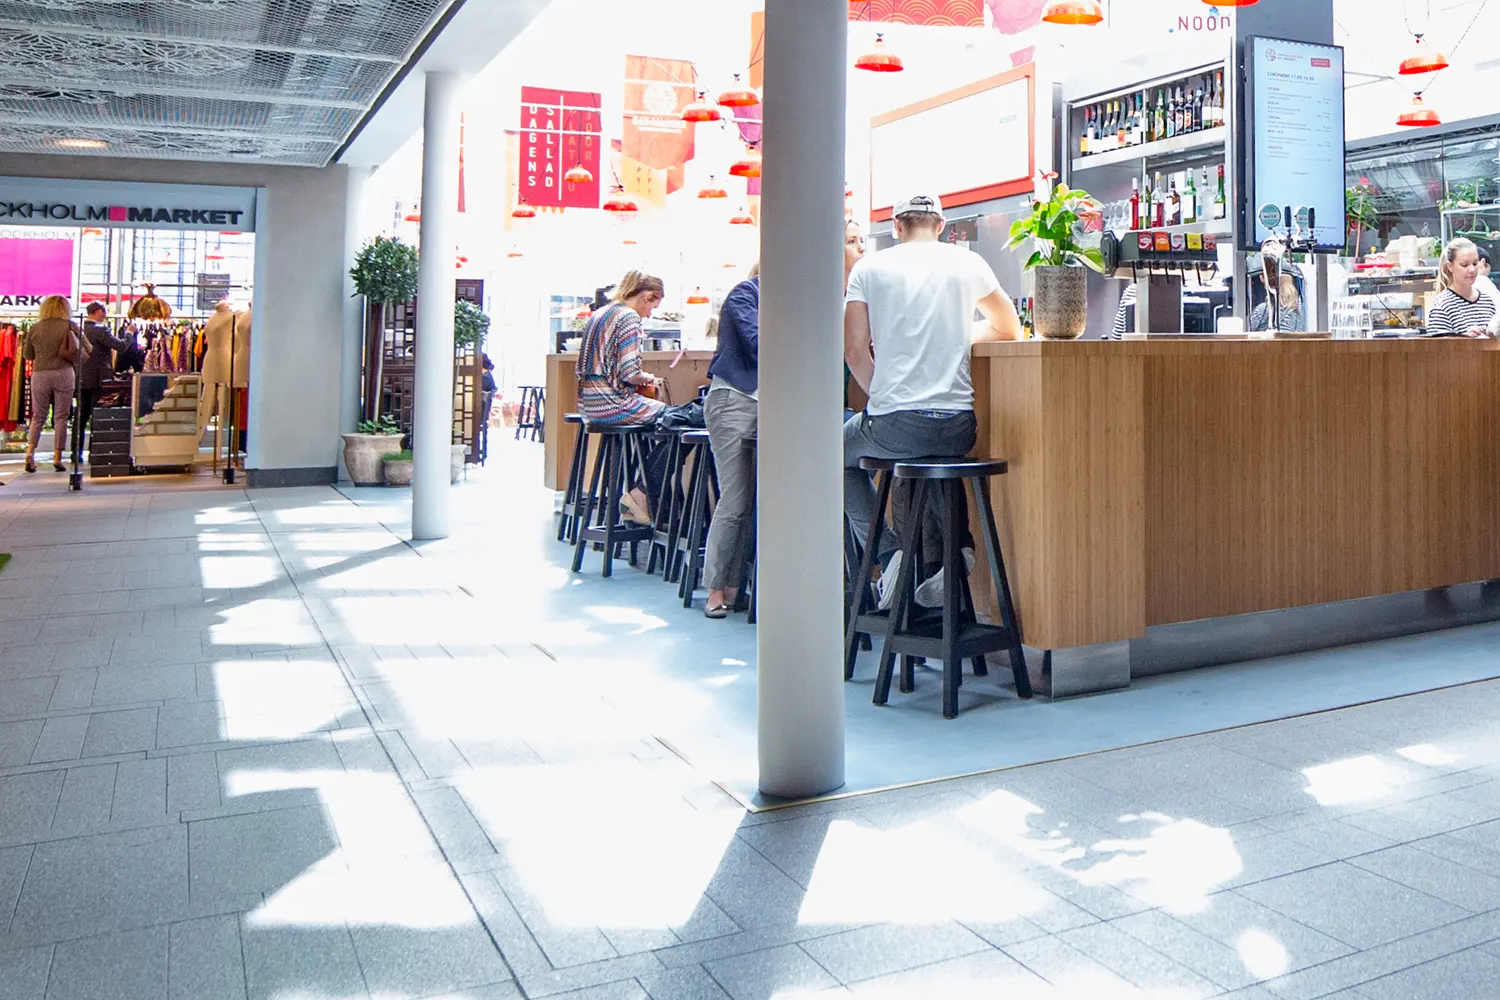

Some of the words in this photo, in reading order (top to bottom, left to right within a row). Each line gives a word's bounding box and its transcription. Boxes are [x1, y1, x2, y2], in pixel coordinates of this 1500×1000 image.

[528, 105, 538, 187] DAGENS
[545, 106, 555, 188] SALLAD
[127, 208, 243, 225] MARKET
